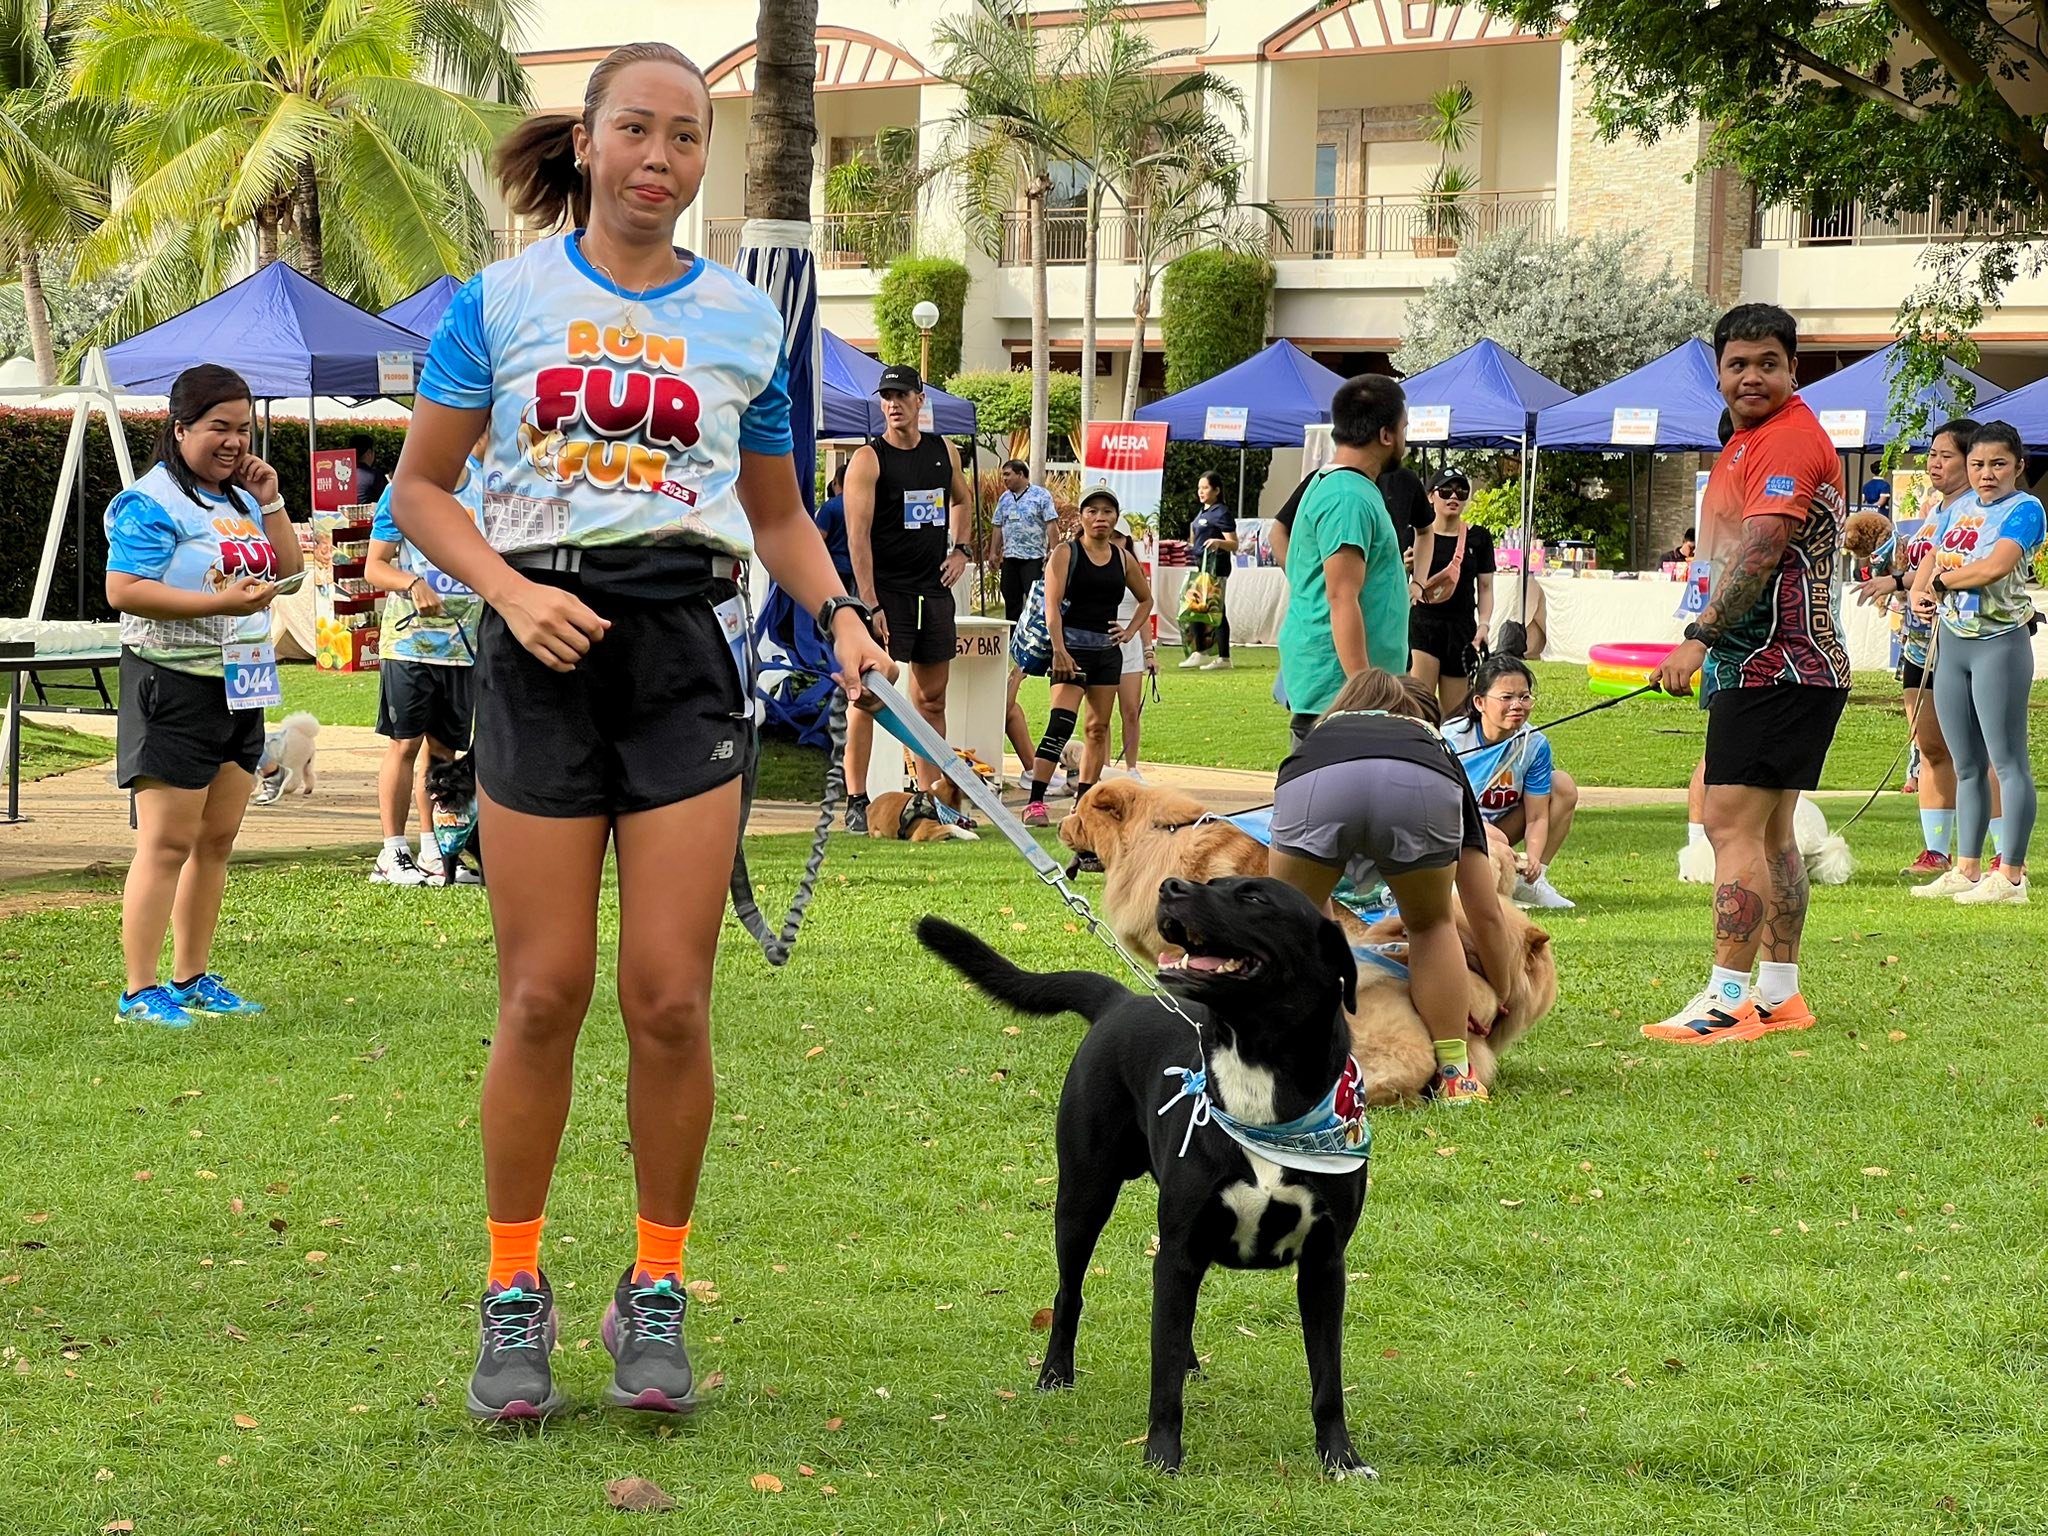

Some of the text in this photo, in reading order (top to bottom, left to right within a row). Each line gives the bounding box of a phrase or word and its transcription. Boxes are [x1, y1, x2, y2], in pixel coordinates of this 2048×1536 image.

[566, 319, 688, 374] RUN
[536, 365, 701, 452] FUR
[1101, 435, 1150, 450] MERA
[557, 440, 671, 492] FUN
[660, 481, 690, 501] 2025
[977, 635, 1001, 656] BAR
[233, 666, 273, 695] 044
